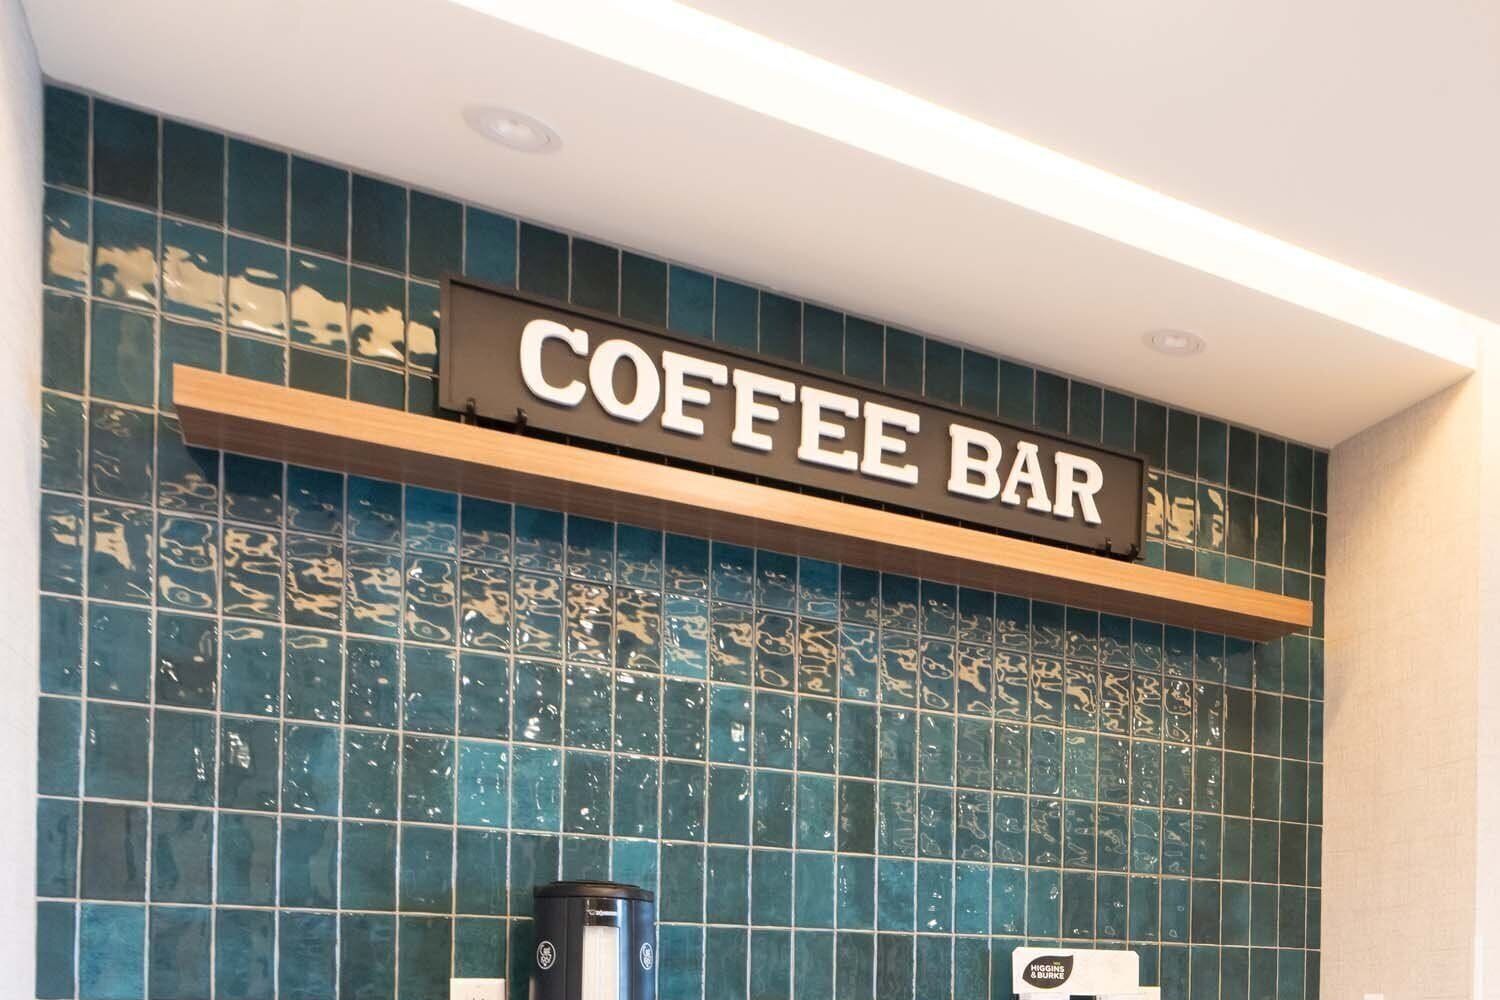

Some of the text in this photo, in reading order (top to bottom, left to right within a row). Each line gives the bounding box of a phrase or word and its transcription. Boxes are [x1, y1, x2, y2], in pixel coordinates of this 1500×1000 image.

[520, 319, 1104, 525] COFFEE BAR
[1031, 965, 1065, 973] HIGGINS
